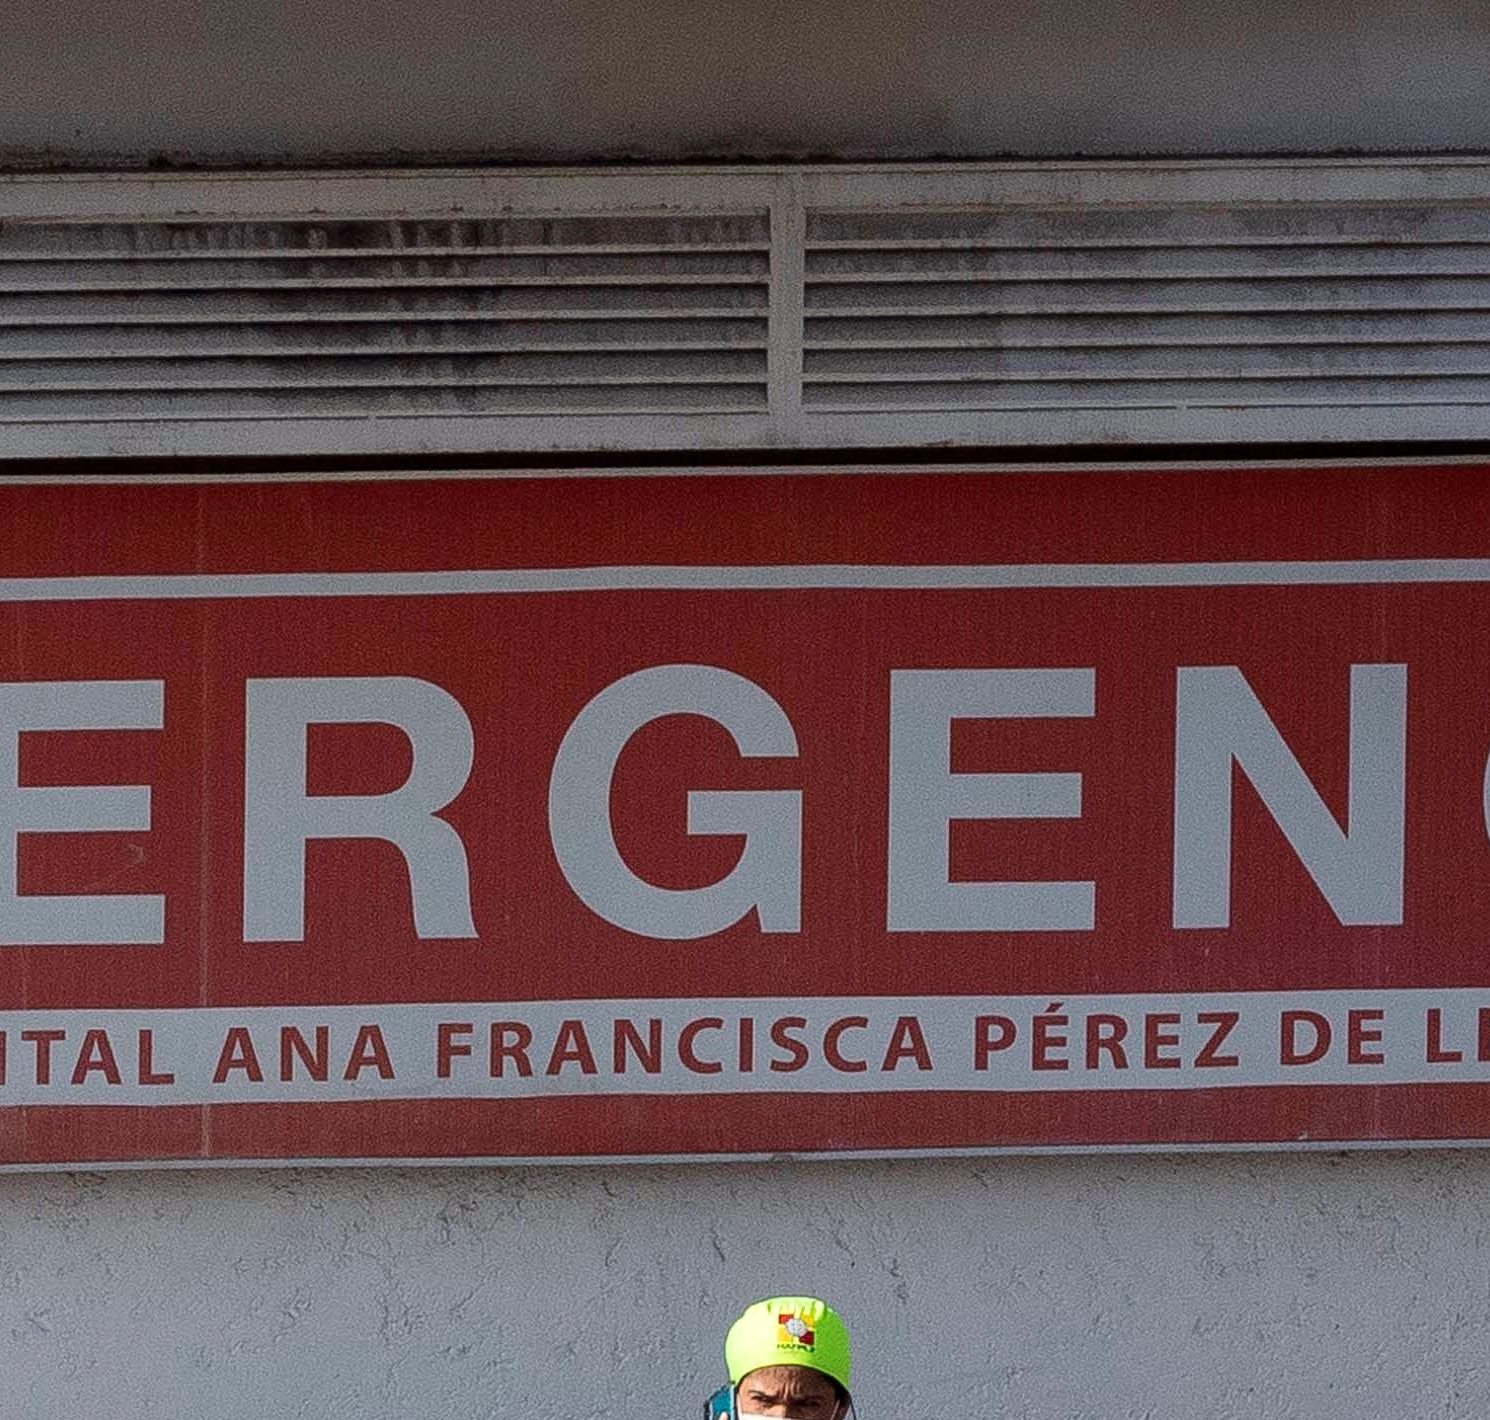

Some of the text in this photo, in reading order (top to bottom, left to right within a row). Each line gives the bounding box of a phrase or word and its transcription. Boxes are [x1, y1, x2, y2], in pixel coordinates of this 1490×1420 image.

[212, 1023, 395, 1083] ANA
[436, 1016, 932, 1079] FRANCISCA
[974, 1002, 1240, 1070] PÉREZ
[1279, 1008, 1383, 1066] DE
